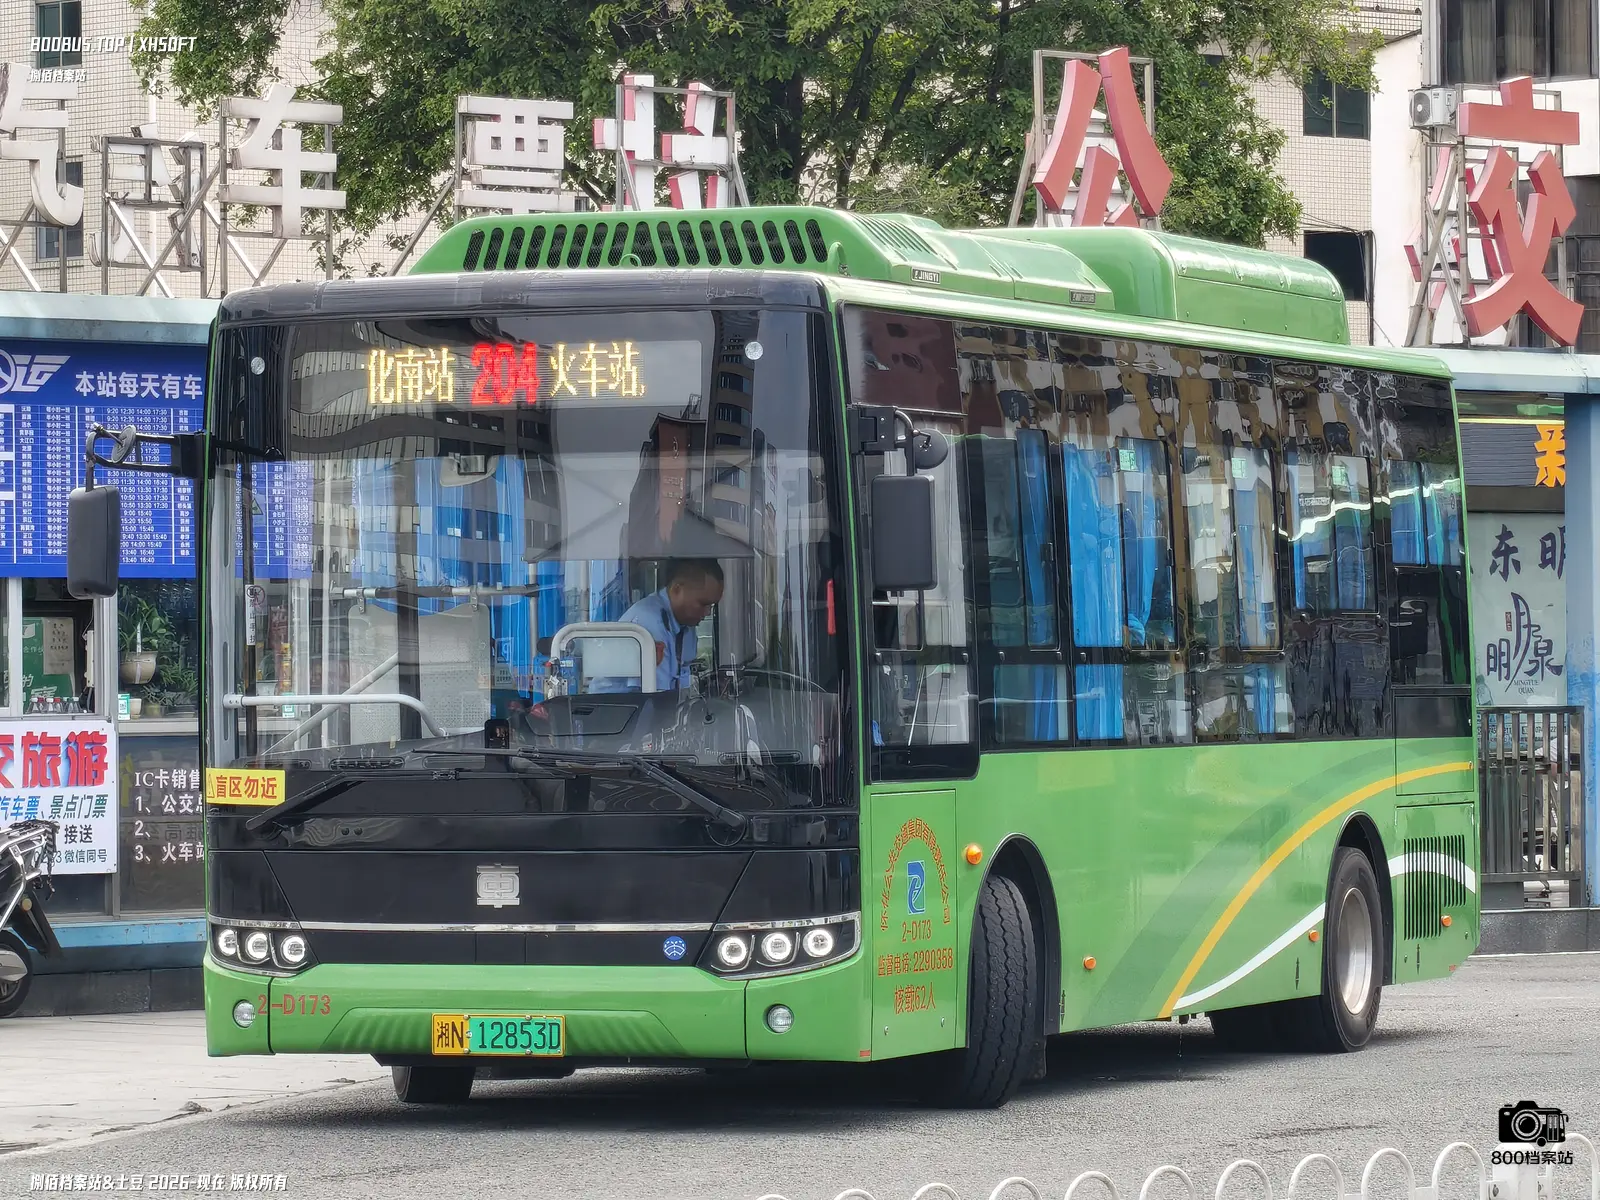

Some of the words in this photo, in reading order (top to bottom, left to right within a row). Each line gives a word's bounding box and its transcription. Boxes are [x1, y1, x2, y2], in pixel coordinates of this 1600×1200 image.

[75, 371, 203, 400] 本站每天有车
[368, 347, 456, 404] 化南站
[471, 341, 541, 405] 204
[550, 341, 640, 398] 火车站
[216, 774, 277, 799] 盲区勿近
[64, 824, 93, 844] 接送
[65, 849, 107, 863] 微信同号
[902, 919, 931, 942] 2-D173
[258, 994, 331, 1016] 2-D173
[894, 981, 936, 1015] 核载62人
[436, 1021, 464, 1049] 湘N
[478, 1021, 561, 1050] 12853D
